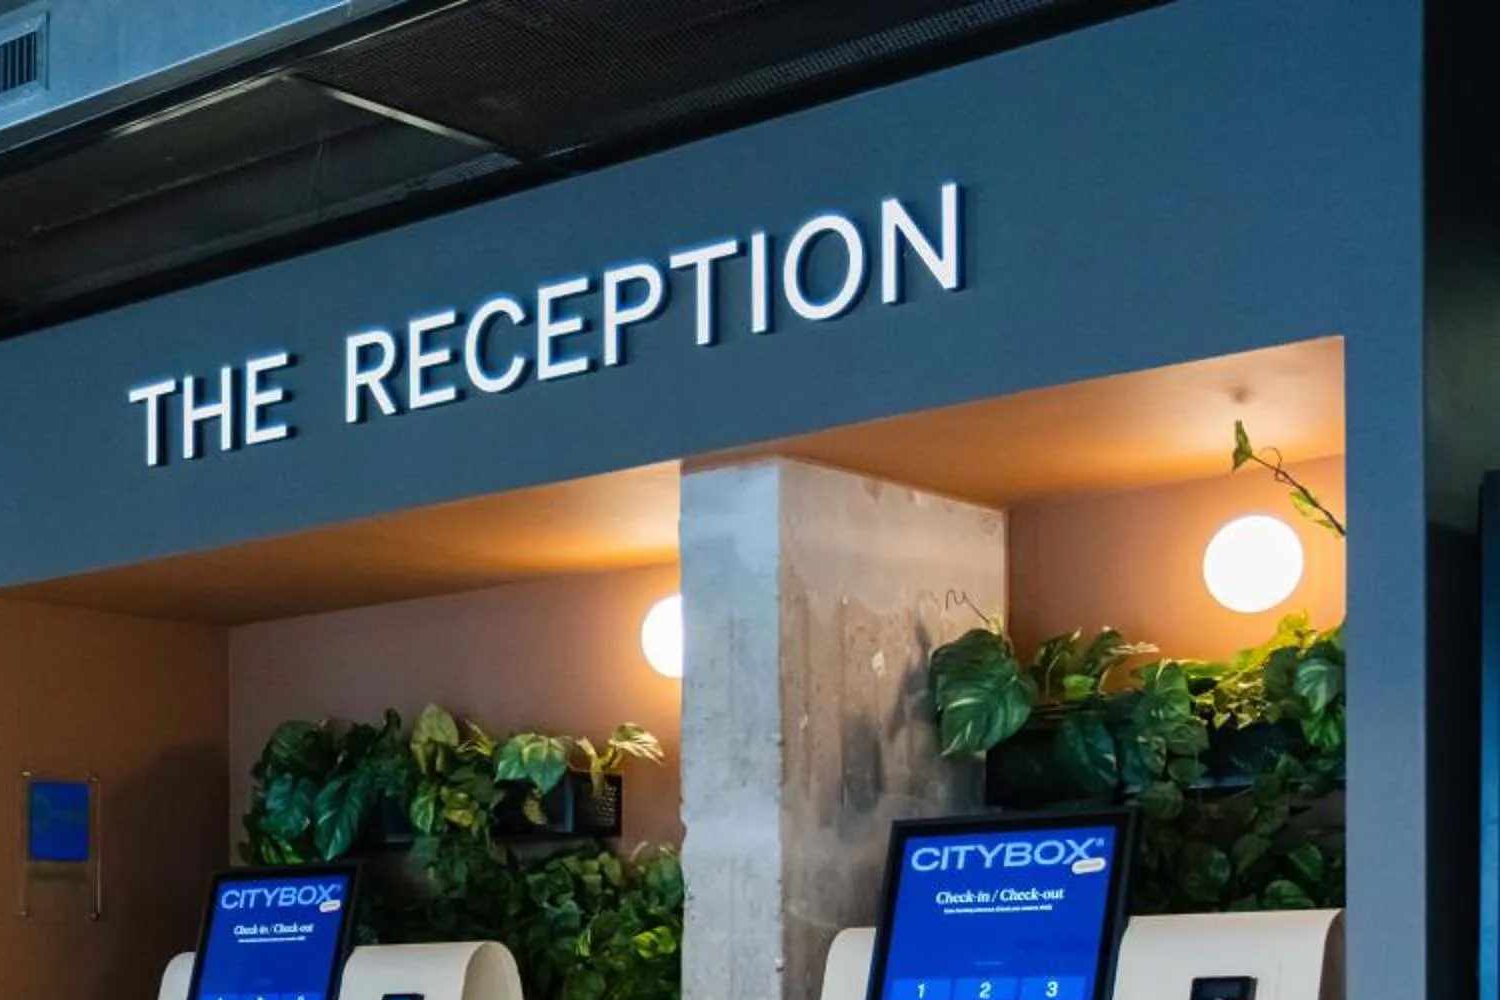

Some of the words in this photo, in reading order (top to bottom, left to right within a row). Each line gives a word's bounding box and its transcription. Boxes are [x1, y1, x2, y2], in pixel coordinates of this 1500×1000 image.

[128, 352, 289, 466] THE
[345, 182, 960, 424] RECEPTION
[911, 838, 1096, 871] CITYBOX
[221, 884, 336, 909] CITYBOX
[935, 889, 991, 904] Check-in
[1000, 887, 1065, 902] Check-out
[917, 983, 925, 999] 1
[979, 981, 992, 999] 2
[1045, 981, 1058, 998] 3
